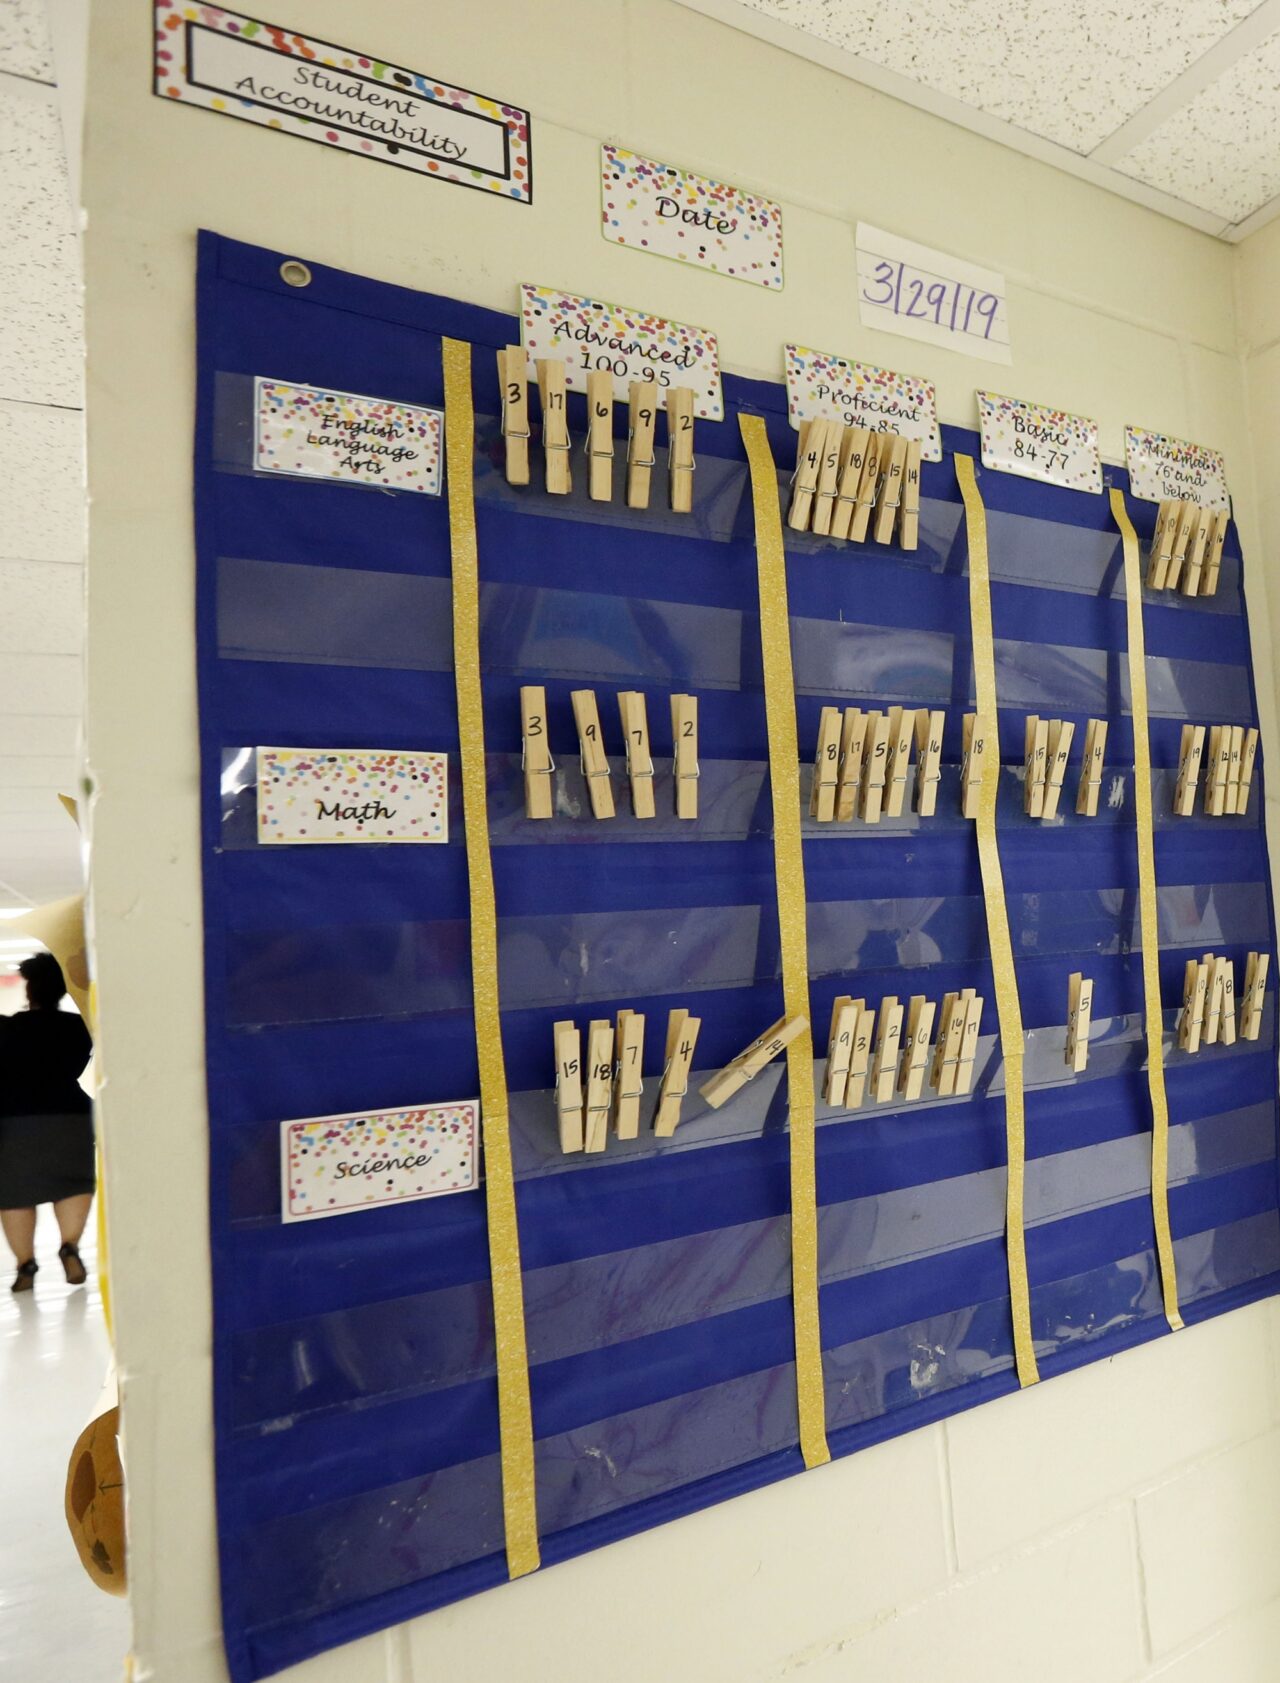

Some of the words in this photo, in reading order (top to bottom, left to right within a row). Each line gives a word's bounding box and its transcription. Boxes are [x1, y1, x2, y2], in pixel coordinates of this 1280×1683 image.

[293, 66, 421, 119] Student
[235, 76, 468, 161] Accountability
[655, 196, 737, 235] Date
[862, 261, 1000, 340] 3/29/19
[553, 320, 696, 368] Advanced
[580, 352, 671, 388] 100-95
[507, 382, 522, 404] 3
[549, 392, 563, 410] 17
[595, 402, 609, 417] 6
[816, 384, 921, 422] Proficient
[321, 414, 405, 438] English
[639, 409, 652, 427] 9
[680, 415, 693, 431] 2
[843, 412, 900, 436] 94-85
[1012, 415, 1070, 446] Basic
[306, 430, 419, 462] Language
[1013, 440, 1070, 470] 84-77
[339, 456, 387, 474] Arts
[807, 451, 817, 469] 4
[827, 453, 838, 468] 5
[849, 453, 862, 469] 18
[1148, 443, 1208, 470] Minimal
[868, 456, 877, 477] 8
[889, 464, 900, 478] 15
[1155, 461, 1171, 478] 76
[1174, 470, 1207, 487] and
[907, 469, 918, 485] 14
[1162, 481, 1201, 503] below
[1200, 528, 1206, 540] 7
[527, 715, 543, 736] 3
[585, 724, 596, 742] 9
[683, 720, 694, 737] 2
[632, 730, 643, 745] 7
[899, 739, 908, 753] 6
[930, 739, 940, 753] 16
[973, 738, 984, 755] 18
[826, 743, 837, 760] 8
[851, 741, 861, 754] 17
[874, 741, 886, 758] 5
[1035, 746, 1046, 761] 15
[1094, 746, 1102, 761] 4
[317, 800, 397, 821] Math
[1225, 979, 1233, 994] 8
[1079, 997, 1090, 1012] 5
[889, 1025, 900, 1039] 2
[951, 1017, 963, 1031] 16
[839, 1031, 850, 1047] 9
[856, 1037, 866, 1052] 3
[917, 1028, 928, 1044] 6
[626, 1046, 638, 1065] 7
[680, 1040, 692, 1062] 4
[563, 1059, 579, 1079] 15
[593, 1063, 611, 1081] 18
[333, 1154, 433, 1180] Science
